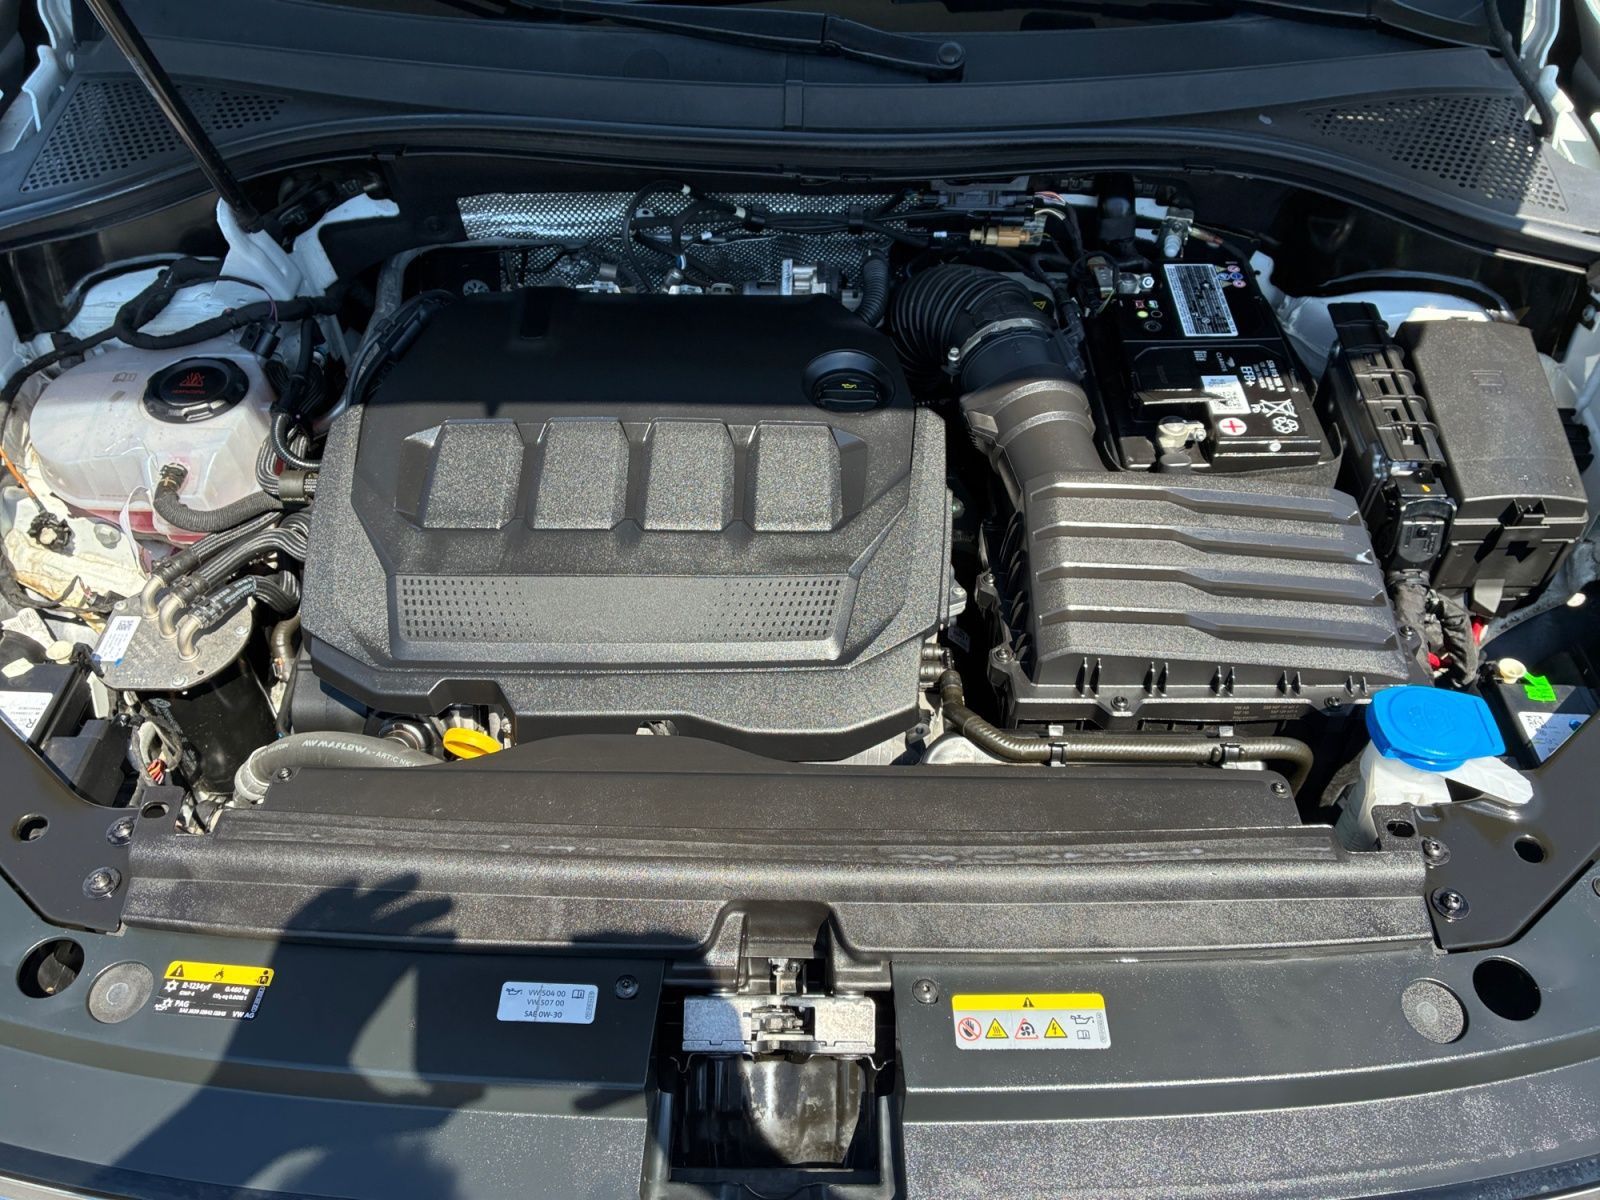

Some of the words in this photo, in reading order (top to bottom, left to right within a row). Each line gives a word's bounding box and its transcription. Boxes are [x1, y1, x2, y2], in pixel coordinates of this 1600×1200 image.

[1240, 366, 1256, 386] EFB+
[318, 740, 367, 753] MAFLOW
[182, 982, 212, 992] R-1234yf
[241, 987, 250, 995] kg
[174, 999, 190, 1007] PAG
[524, 1010, 537, 1018] SAE
[538, 1010, 563, 1018] 0W-30
